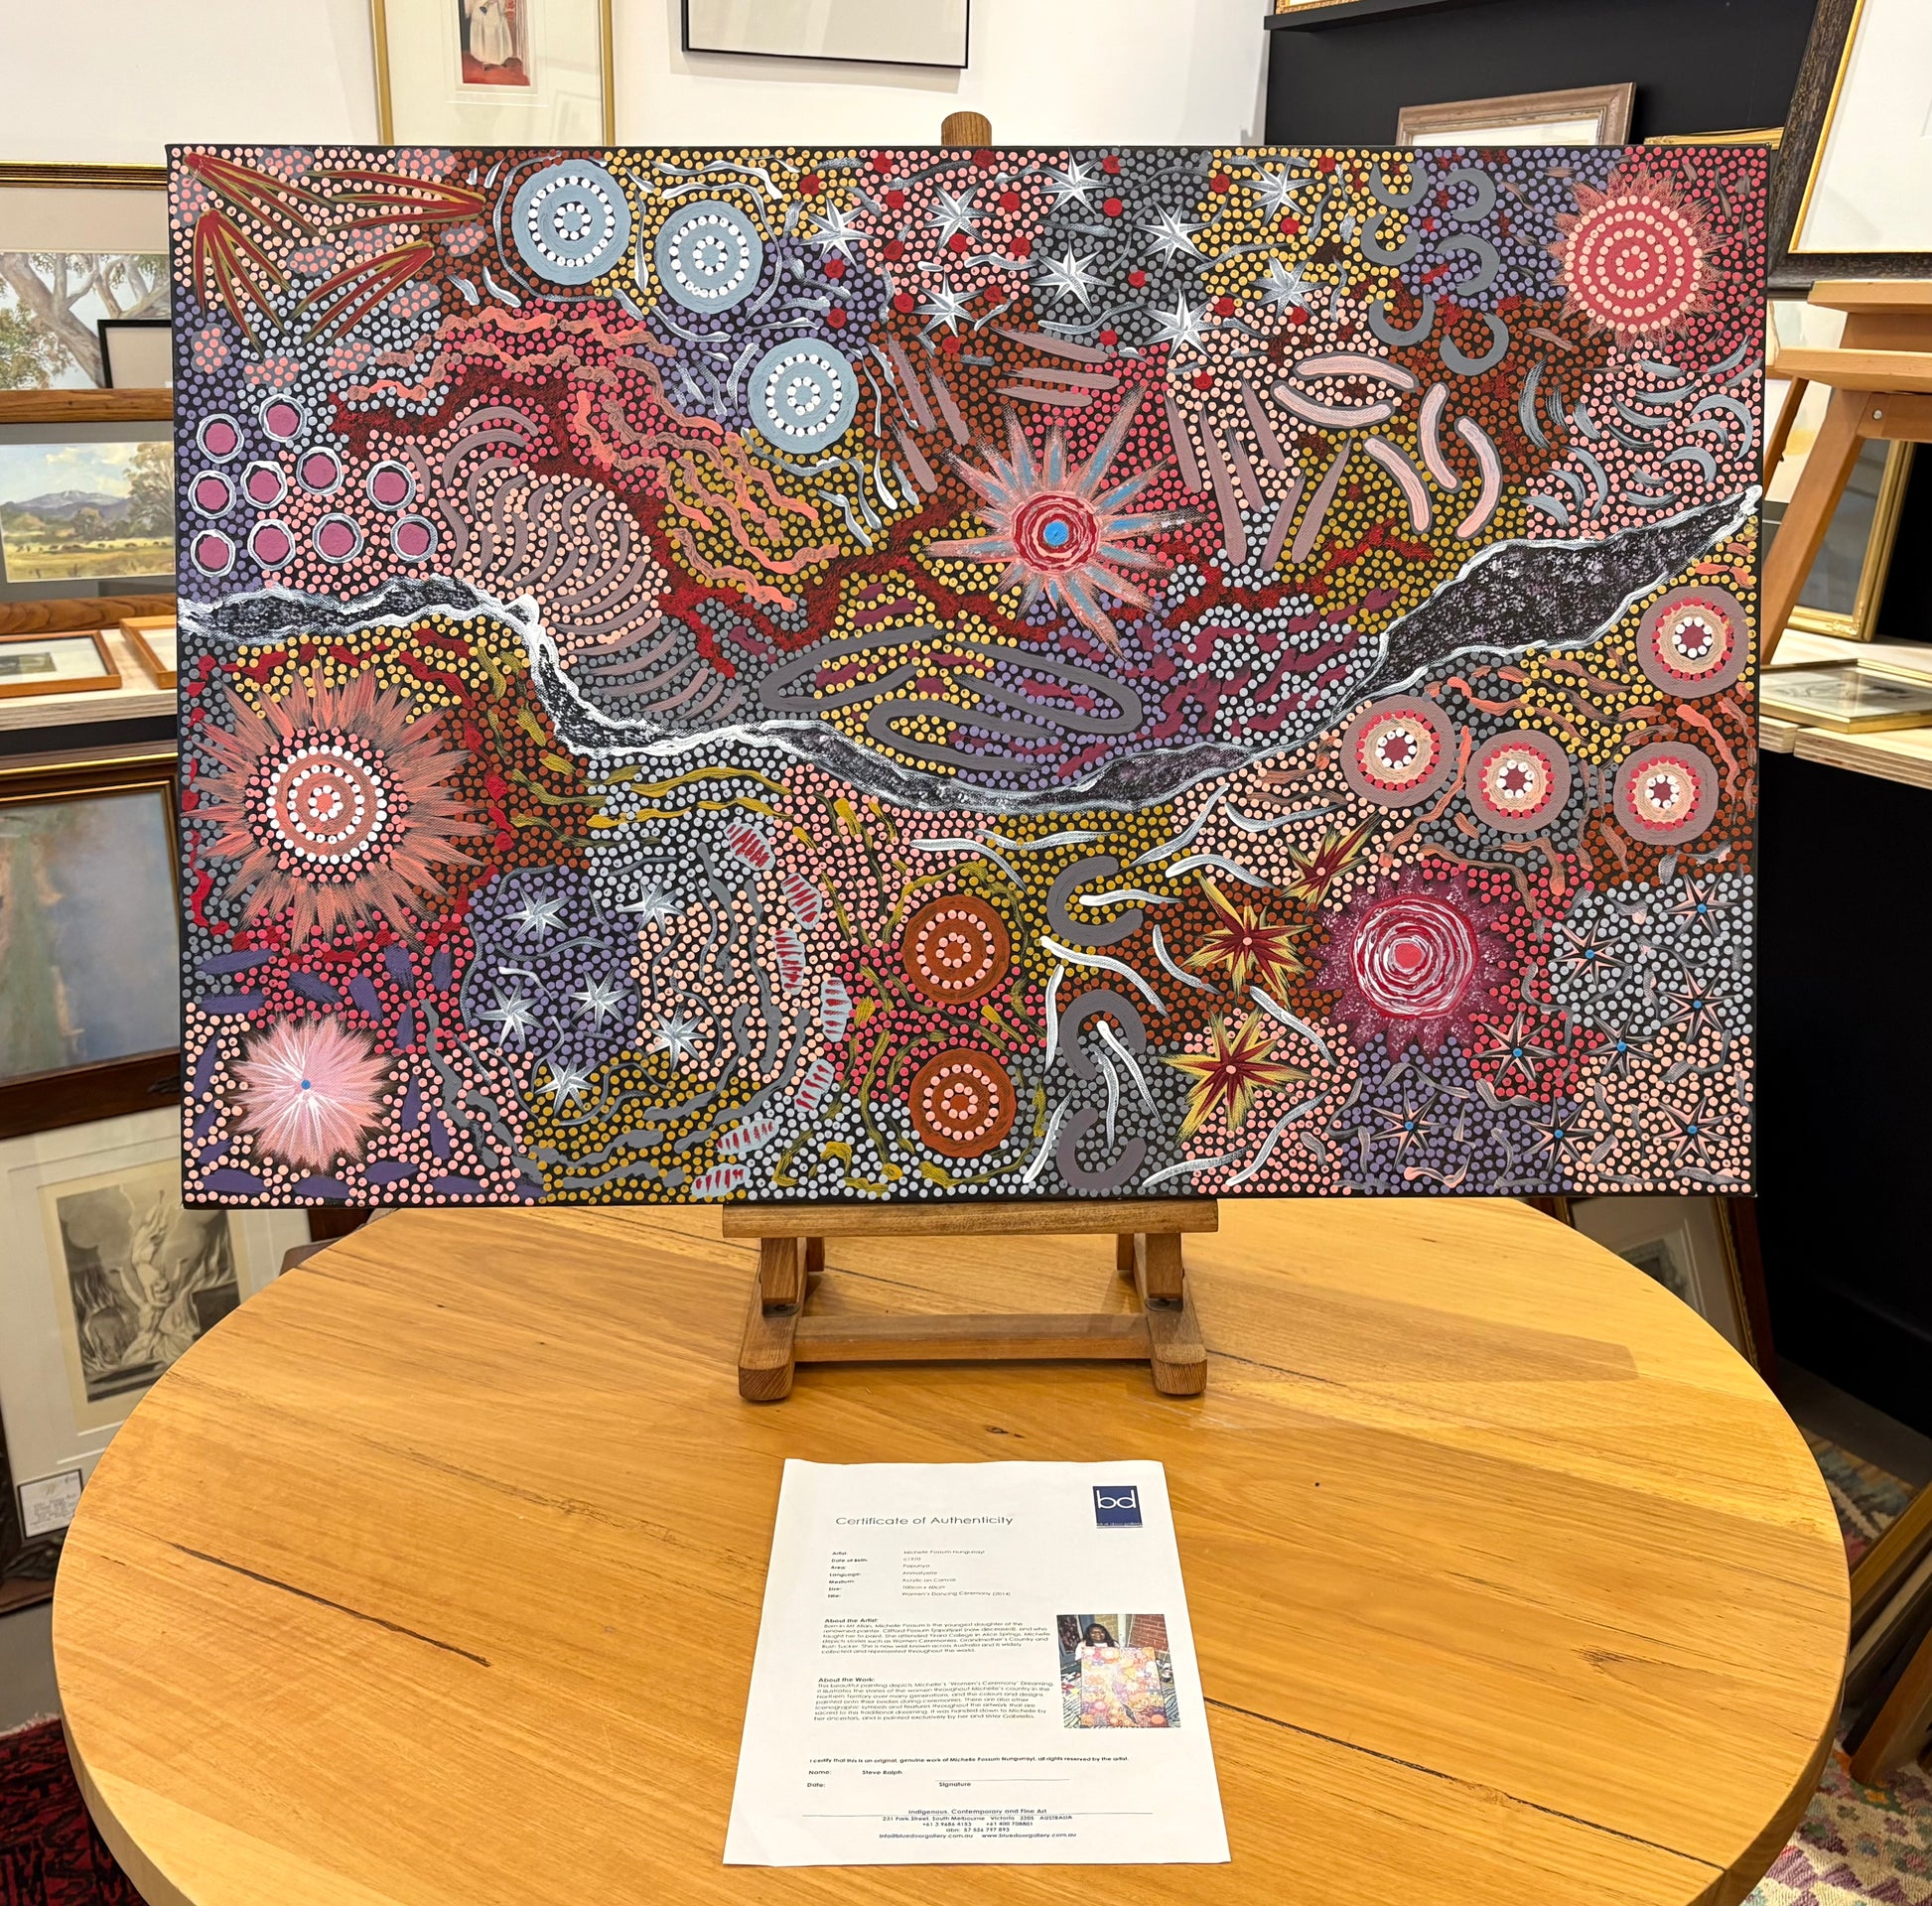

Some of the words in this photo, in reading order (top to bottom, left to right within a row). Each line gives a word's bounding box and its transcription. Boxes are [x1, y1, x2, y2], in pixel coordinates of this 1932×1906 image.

[1096, 1489, 1137, 1509] bd
[836, 1517, 908, 1526] Certificate
[931, 1517, 1014, 1526] Authenticity
